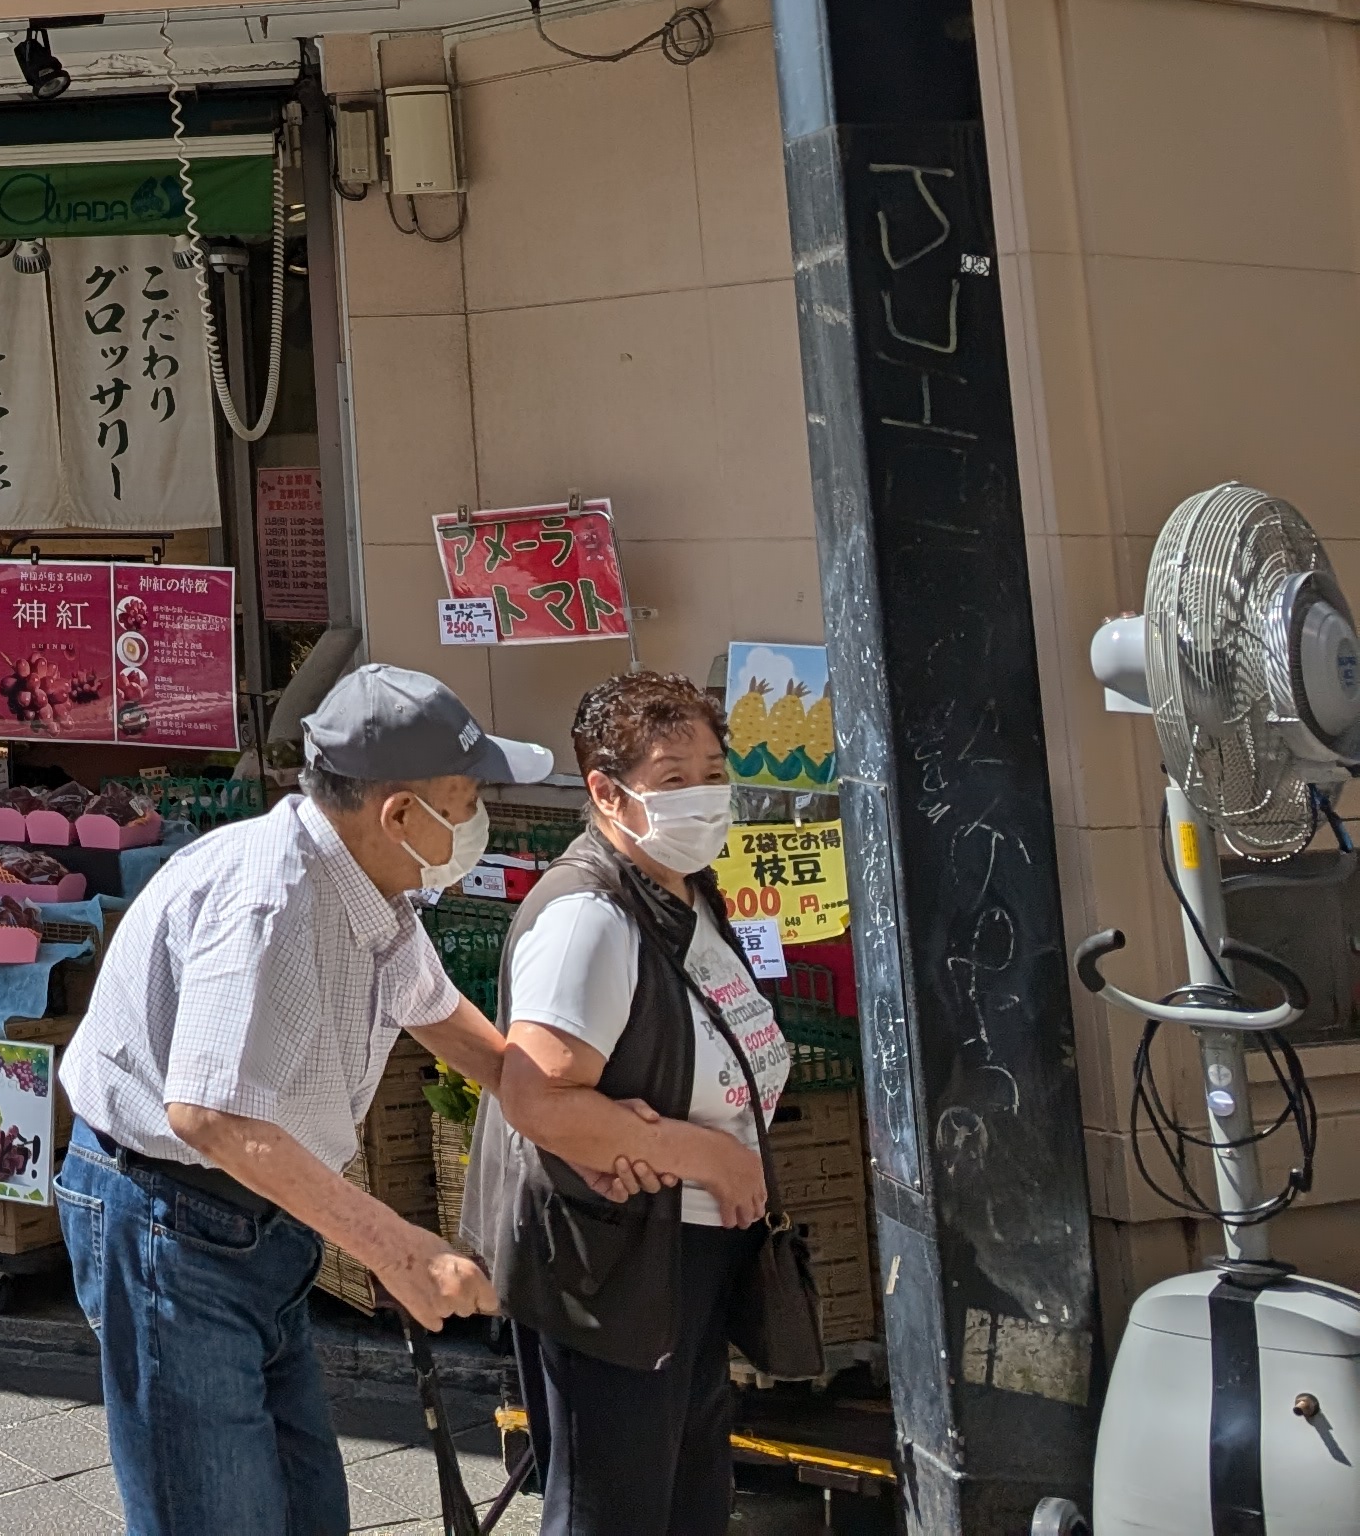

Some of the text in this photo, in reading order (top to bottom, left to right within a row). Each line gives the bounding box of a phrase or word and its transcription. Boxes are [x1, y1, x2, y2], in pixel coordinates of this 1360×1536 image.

[140, 265, 180, 423] こだわり
[84, 265, 133, 502] グロッサリー
[440, 516, 576, 577] アメーラ
[139, 575, 209, 594] 神紅の特徴
[12, 597, 92, 631] 神紅
[454, 609, 493, 622] アメーラ
[490, 579, 618, 636] トマト
[446, 621, 476, 634] 2500
[741, 828, 842, 854] 2袋でお得
[751, 852, 827, 888] 枝豆
[784, 916, 802, 927] 648
[799, 894, 820, 915] 円
[703, 972, 751, 1007] beyond
